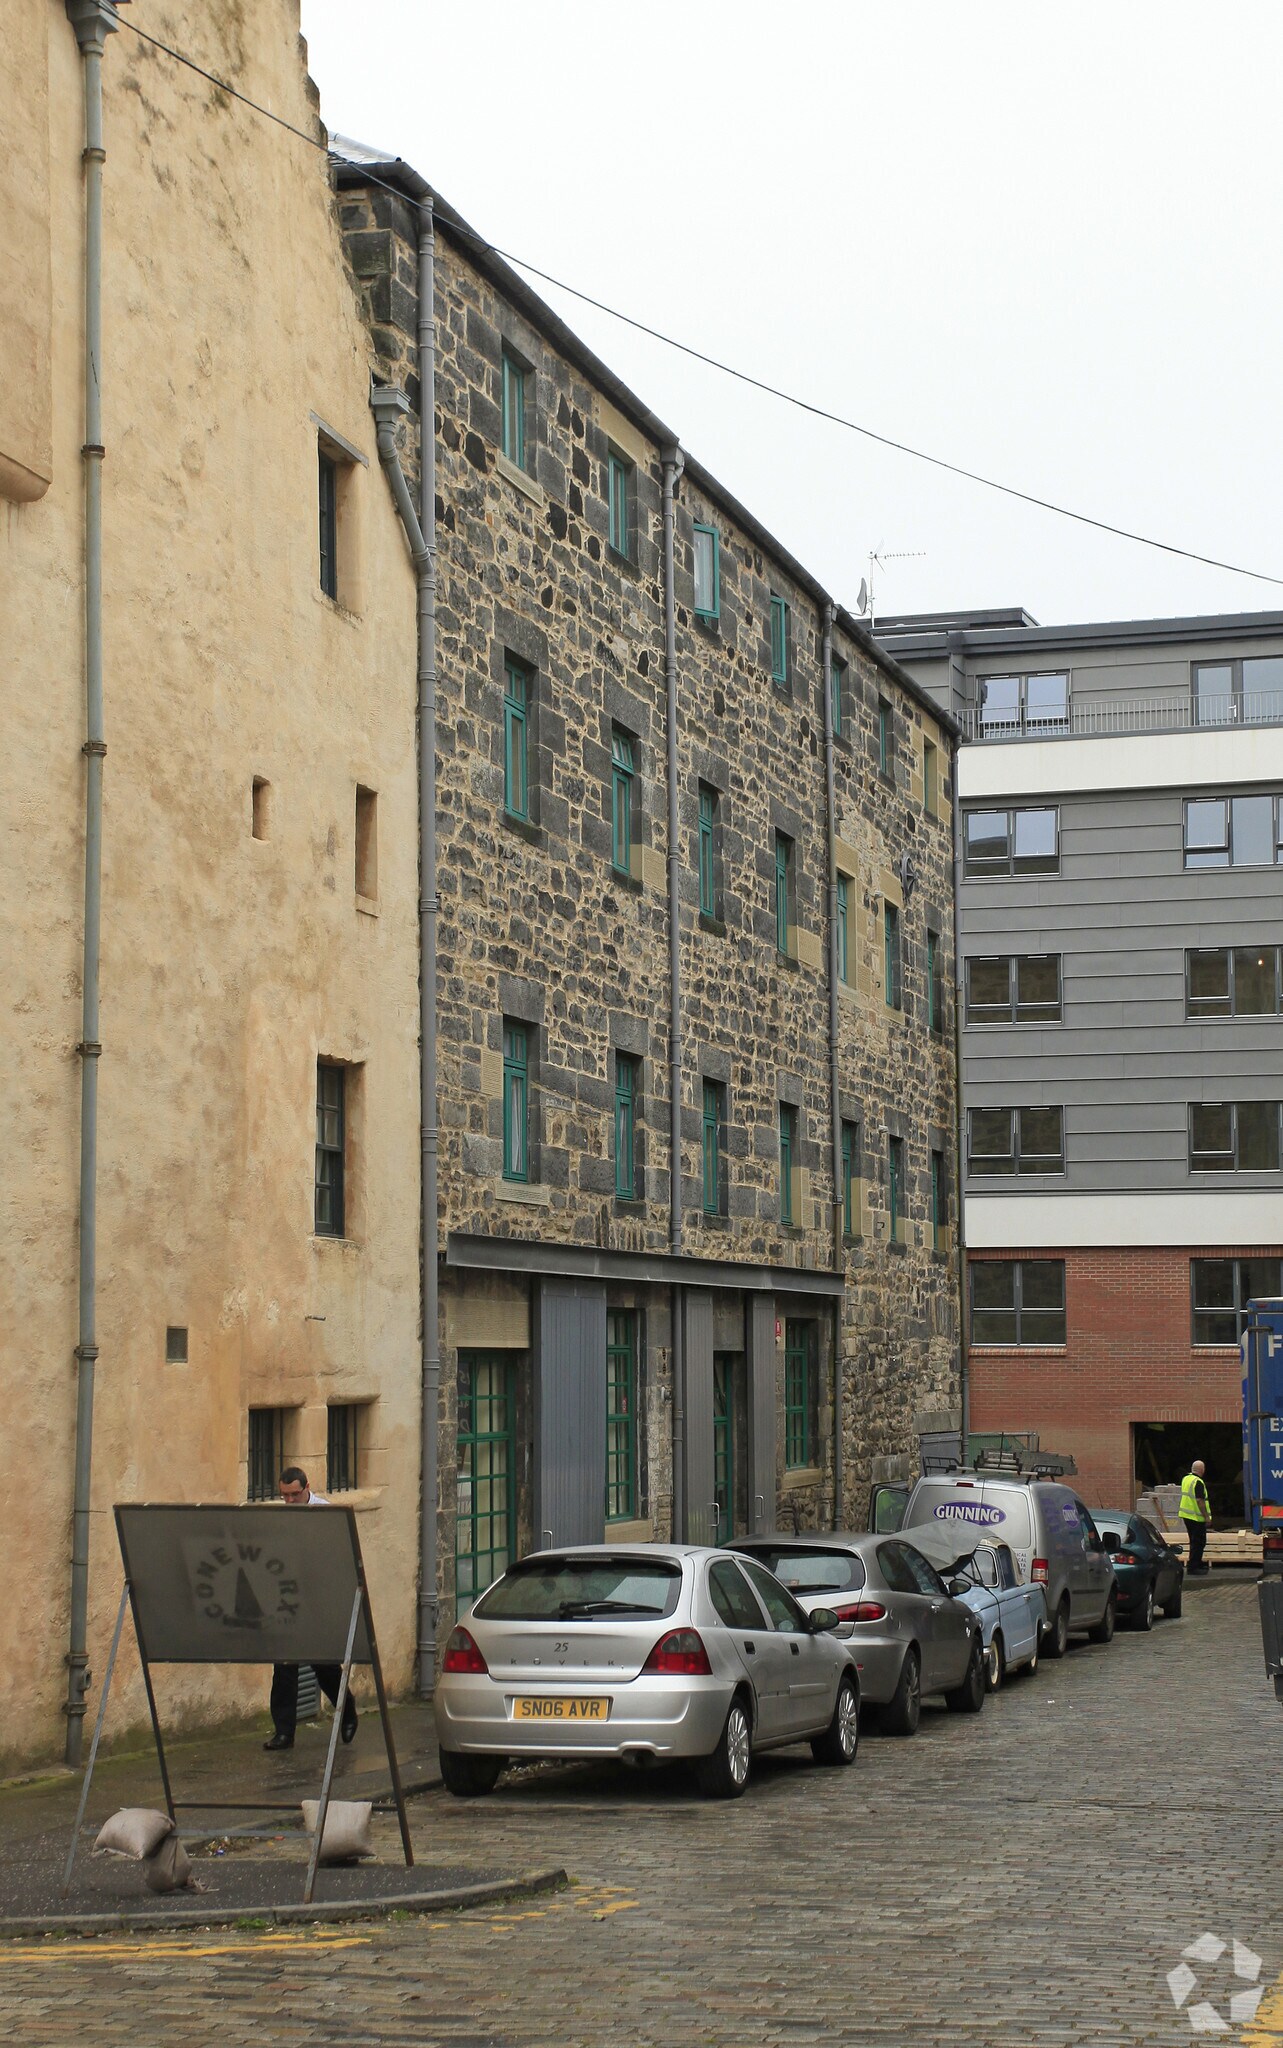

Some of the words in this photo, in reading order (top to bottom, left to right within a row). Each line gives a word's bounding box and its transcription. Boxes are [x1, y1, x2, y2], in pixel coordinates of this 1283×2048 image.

[936, 1505, 1000, 1523] GUNNING
[195, 1543, 299, 1619] CONEWORX
[554, 1642, 569, 1653] 25
[521, 1701, 563, 1717] SN06
[568, 1701, 600, 1717] AVR
